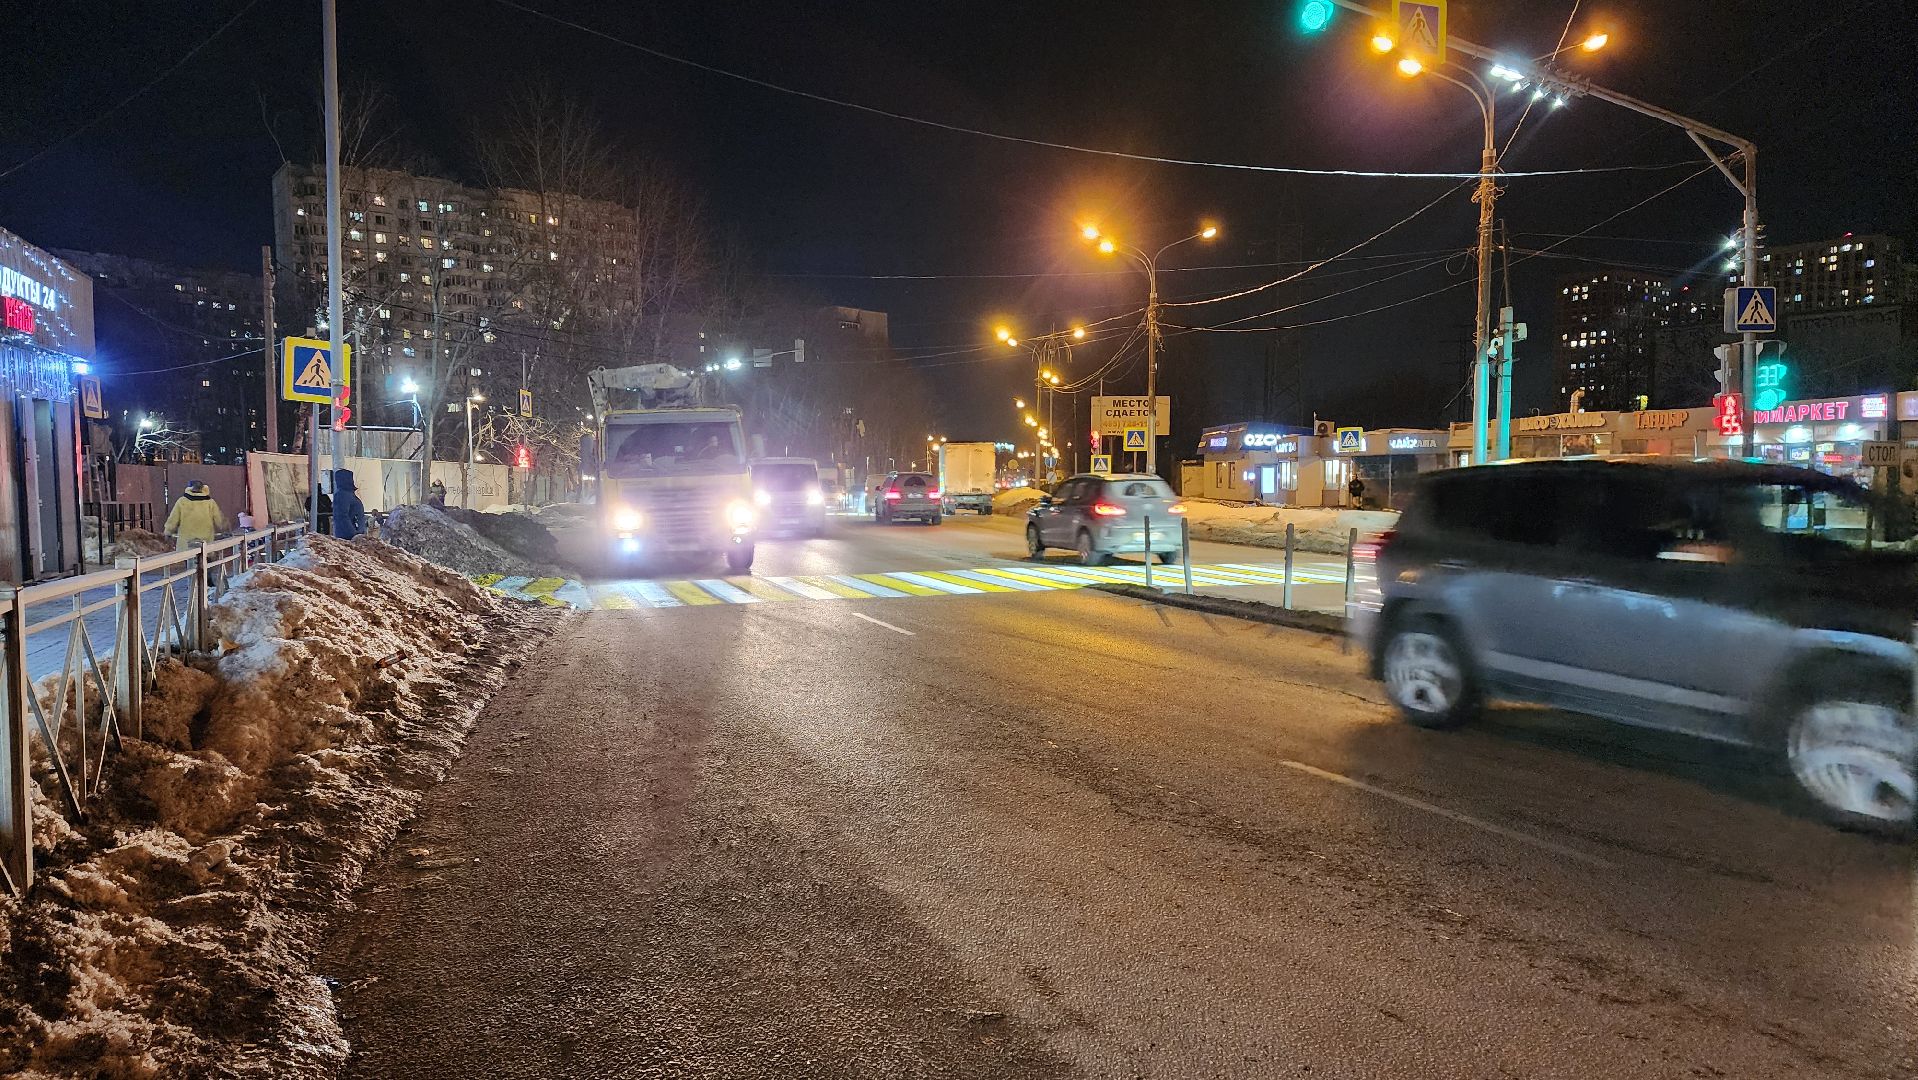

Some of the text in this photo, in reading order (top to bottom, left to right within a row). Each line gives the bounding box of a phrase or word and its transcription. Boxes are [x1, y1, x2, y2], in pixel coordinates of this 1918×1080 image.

[0, 265, 56, 311] ДУКТЫ 24
[1106, 409, 1156, 418] СДАЕТС
[1721, 415, 1741, 434] 55
[1868, 446, 1896, 461] СТОП
